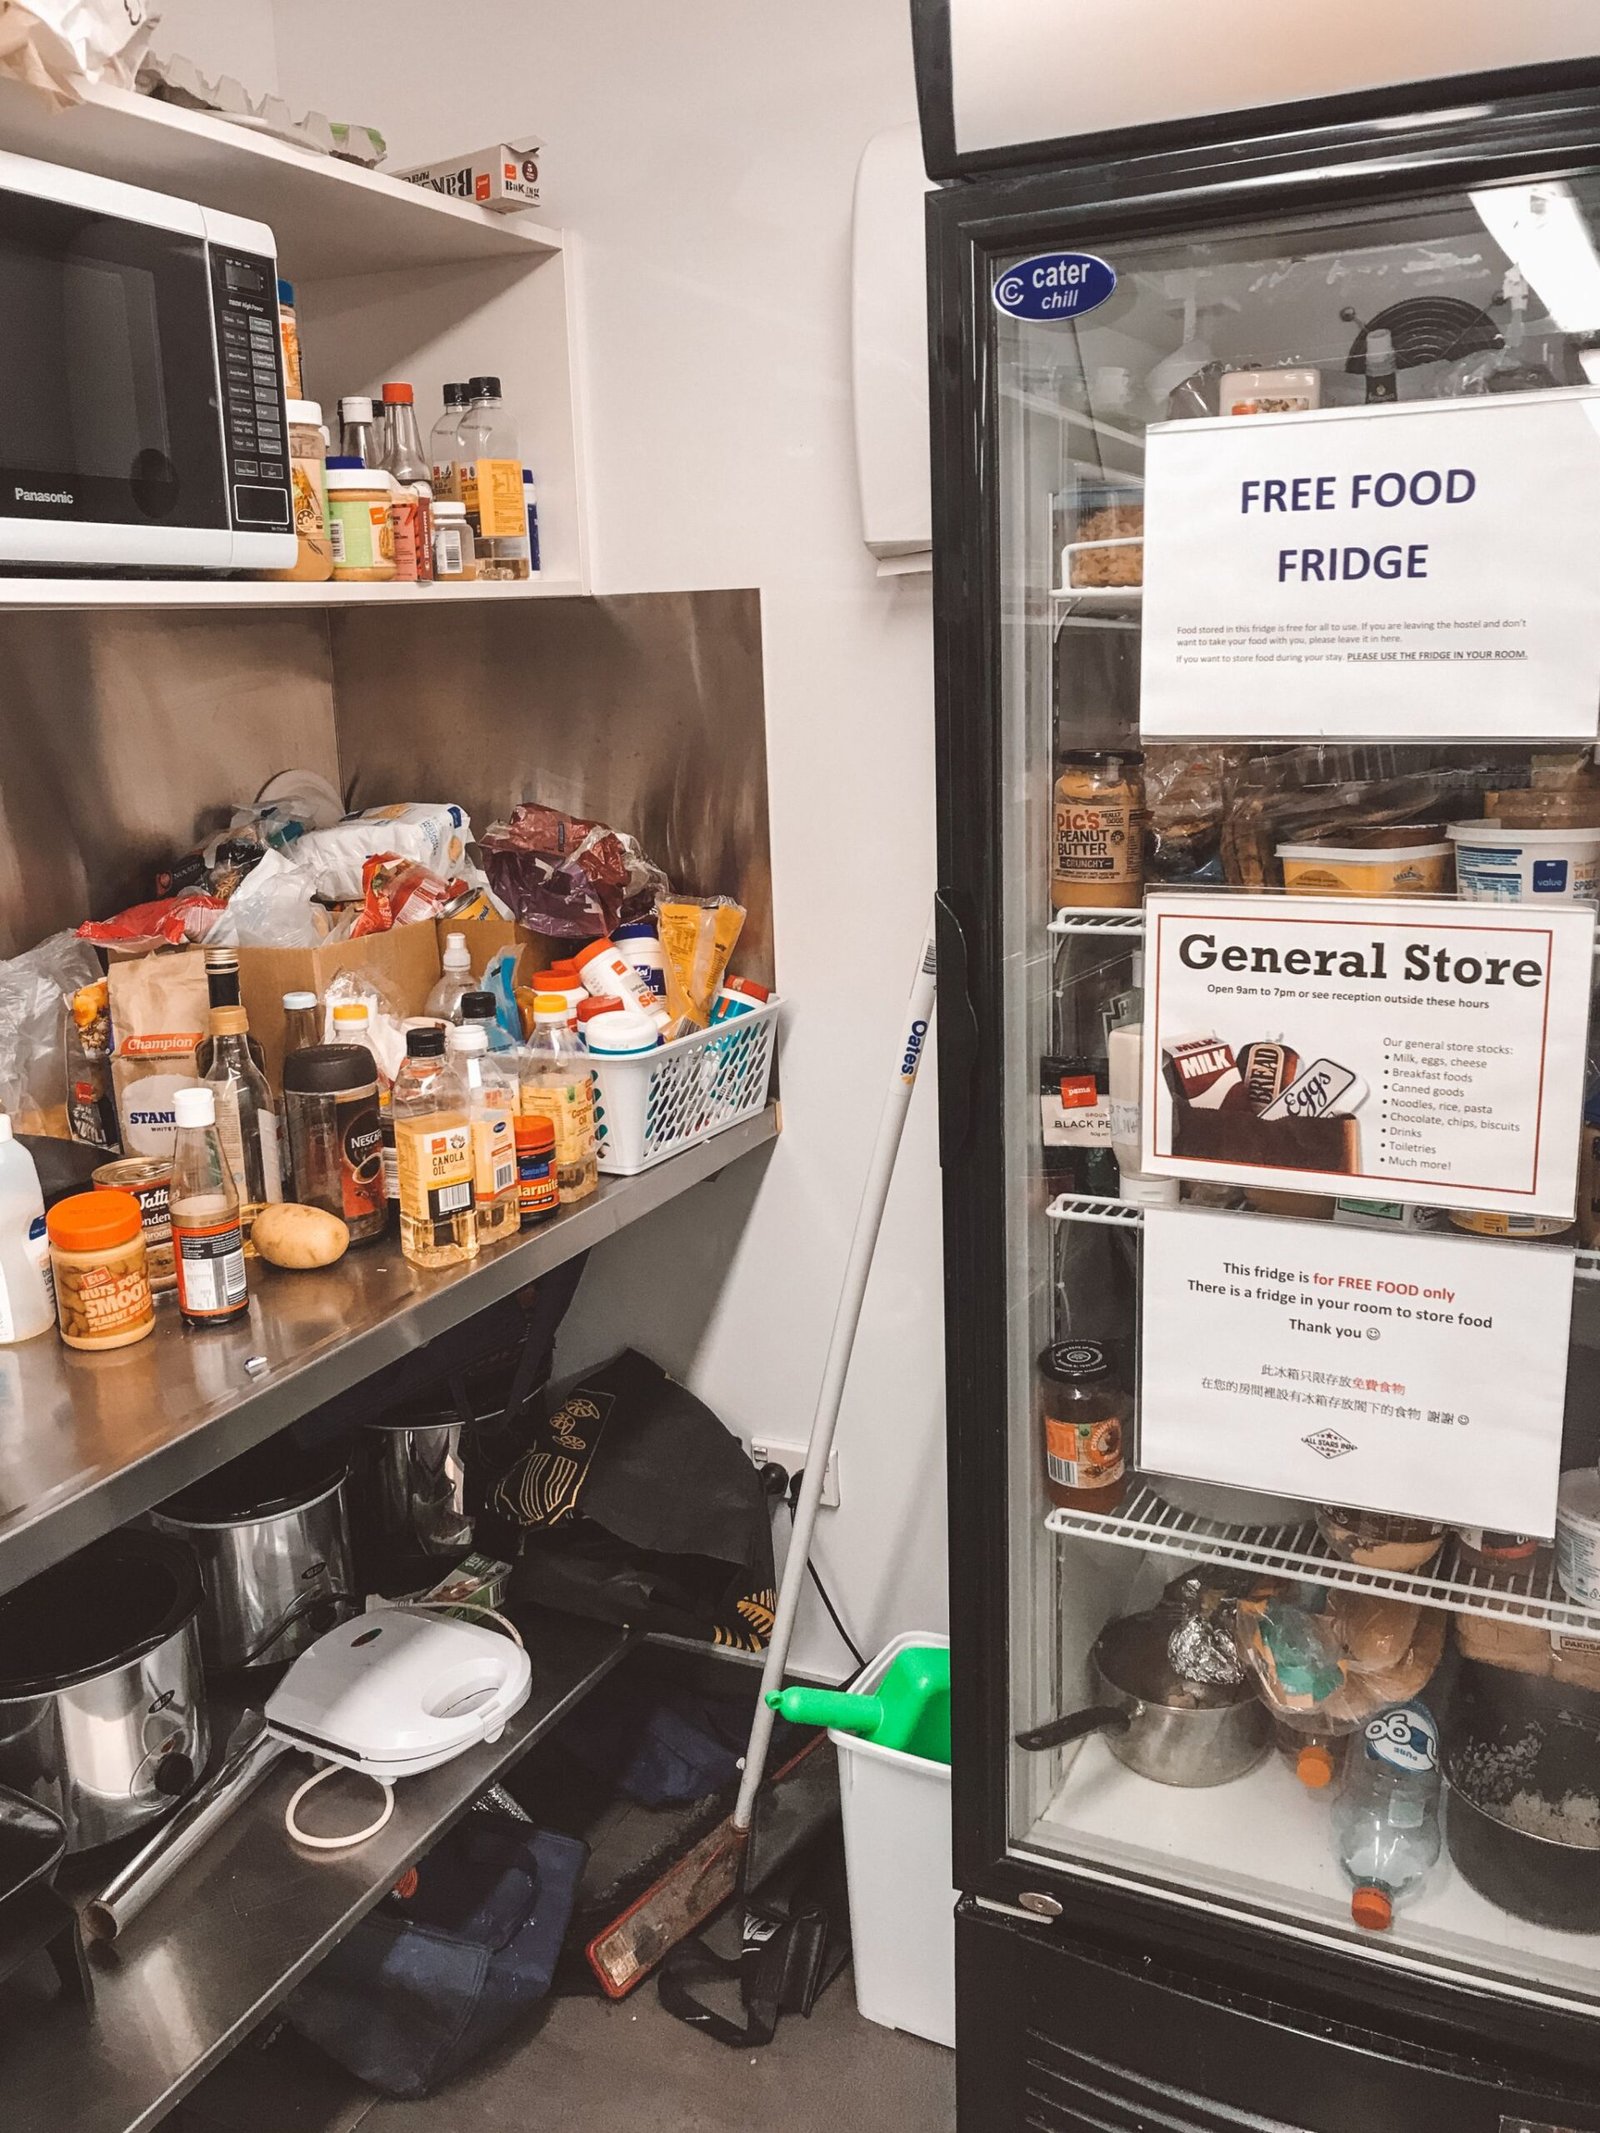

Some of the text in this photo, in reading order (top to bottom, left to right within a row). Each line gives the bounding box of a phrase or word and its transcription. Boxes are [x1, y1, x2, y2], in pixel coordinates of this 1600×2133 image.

[1032, 260, 1091, 288] cater
[1041, 289, 1079, 310] chill
[14, 487, 74, 504] Panasonic
[1241, 468, 1476, 514] FREE FOOD
[1278, 544, 1429, 582] FRIDGE
[1176, 625, 1197, 635] Food
[1198, 625, 1225, 634] stored
[1234, 624, 1250, 633] this
[1251, 624, 1276, 634] fridge
[1277, 624, 1285, 632] is
[1285, 623, 1304, 632] free
[1304, 623, 1317, 632] for
[1318, 622, 1329, 631] all
[1361, 621, 1368, 631] If
[1369, 623, 1386, 632] you
[1403, 621, 1435, 631] leaving
[1436, 620, 1452, 629] the
[1453, 619, 1482, 629] hostel
[1482, 619, 1500, 629] and
[1176, 638, 1197, 647] want
[1197, 638, 1208, 646] to
[1208, 637, 1226, 646] take
[1227, 638, 1247, 647] your
[1247, 636, 1268, 645] food
[1268, 635, 1288, 645] with
[1288, 637, 1307, 646] you,
[1308, 635, 1336, 645] please
[1337, 635, 1360, 643] leave
[1361, 634, 1369, 643] it
[1380, 634, 1402, 642] here.
[1175, 654, 1182, 663] If
[1183, 656, 1199, 664] you
[1199, 655, 1220, 663] want
[1254, 653, 1275, 662] food
[1275, 653, 1303, 663] during
[1303, 654, 1324, 662] your
[1347, 652, 1378, 660] PLEASE
[1380, 651, 1397, 660] USE
[1400, 651, 1416, 660] THE
[1419, 651, 1451, 659] FRIDGE
[1453, 651, 1464, 659] IN
[1466, 650, 1492, 659] YOUR
[1494, 650, 1528, 659] ROOM.
[1060, 830, 1110, 842] PEANUT
[1058, 843, 1107, 855] BUTTER
[1066, 858, 1104, 868] CRUNCHY
[1537, 878, 1562, 887] value
[1178, 933, 1542, 987] General Store
[1207, 983, 1490, 1009] Open 9am to 7pm or see reception outside these hours
[128, 1036, 193, 1051] Champion
[901, 1020, 928, 1075] Oates
[1382, 1036, 1513, 1055] Our general store stocks:
[1180, 1048, 1231, 1079] MILK
[1392, 1052, 1487, 1069] Milk, eggs, cheese
[1250, 1051, 1278, 1100] BREAD
[1392, 1067, 1473, 1083] Breakfast foods
[1284, 1071, 1331, 1118] Eggs
[1391, 1082, 1465, 1098] Canned goods
[1390, 1097, 1493, 1114] Noodles, rice, pasta
[1054, 1119, 1094, 1129] BLACK
[1389, 1111, 1520, 1132] Chocolate, chips, biscuits
[1389, 1126, 1422, 1138] Drinks
[1388, 1140, 1437, 1154] Toiletries
[432, 1152, 465, 1168] CANOLA
[1388, 1155, 1451, 1170] Much more!
[433, 1166, 446, 1177] OIL
[80, 1271, 141, 1300] NUTS FOR
[1222, 1262, 1455, 1303] This fridge is for FREE FOOD only
[1187, 1279, 1492, 1329] There is a fridge in your room to store food
[88, 1308, 128, 1327] PEANUT
[1288, 1318, 1362, 1339] Thank you
[1318, 1440, 1338, 1448] STARS
[1341, 1443, 1355, 1451] INN
